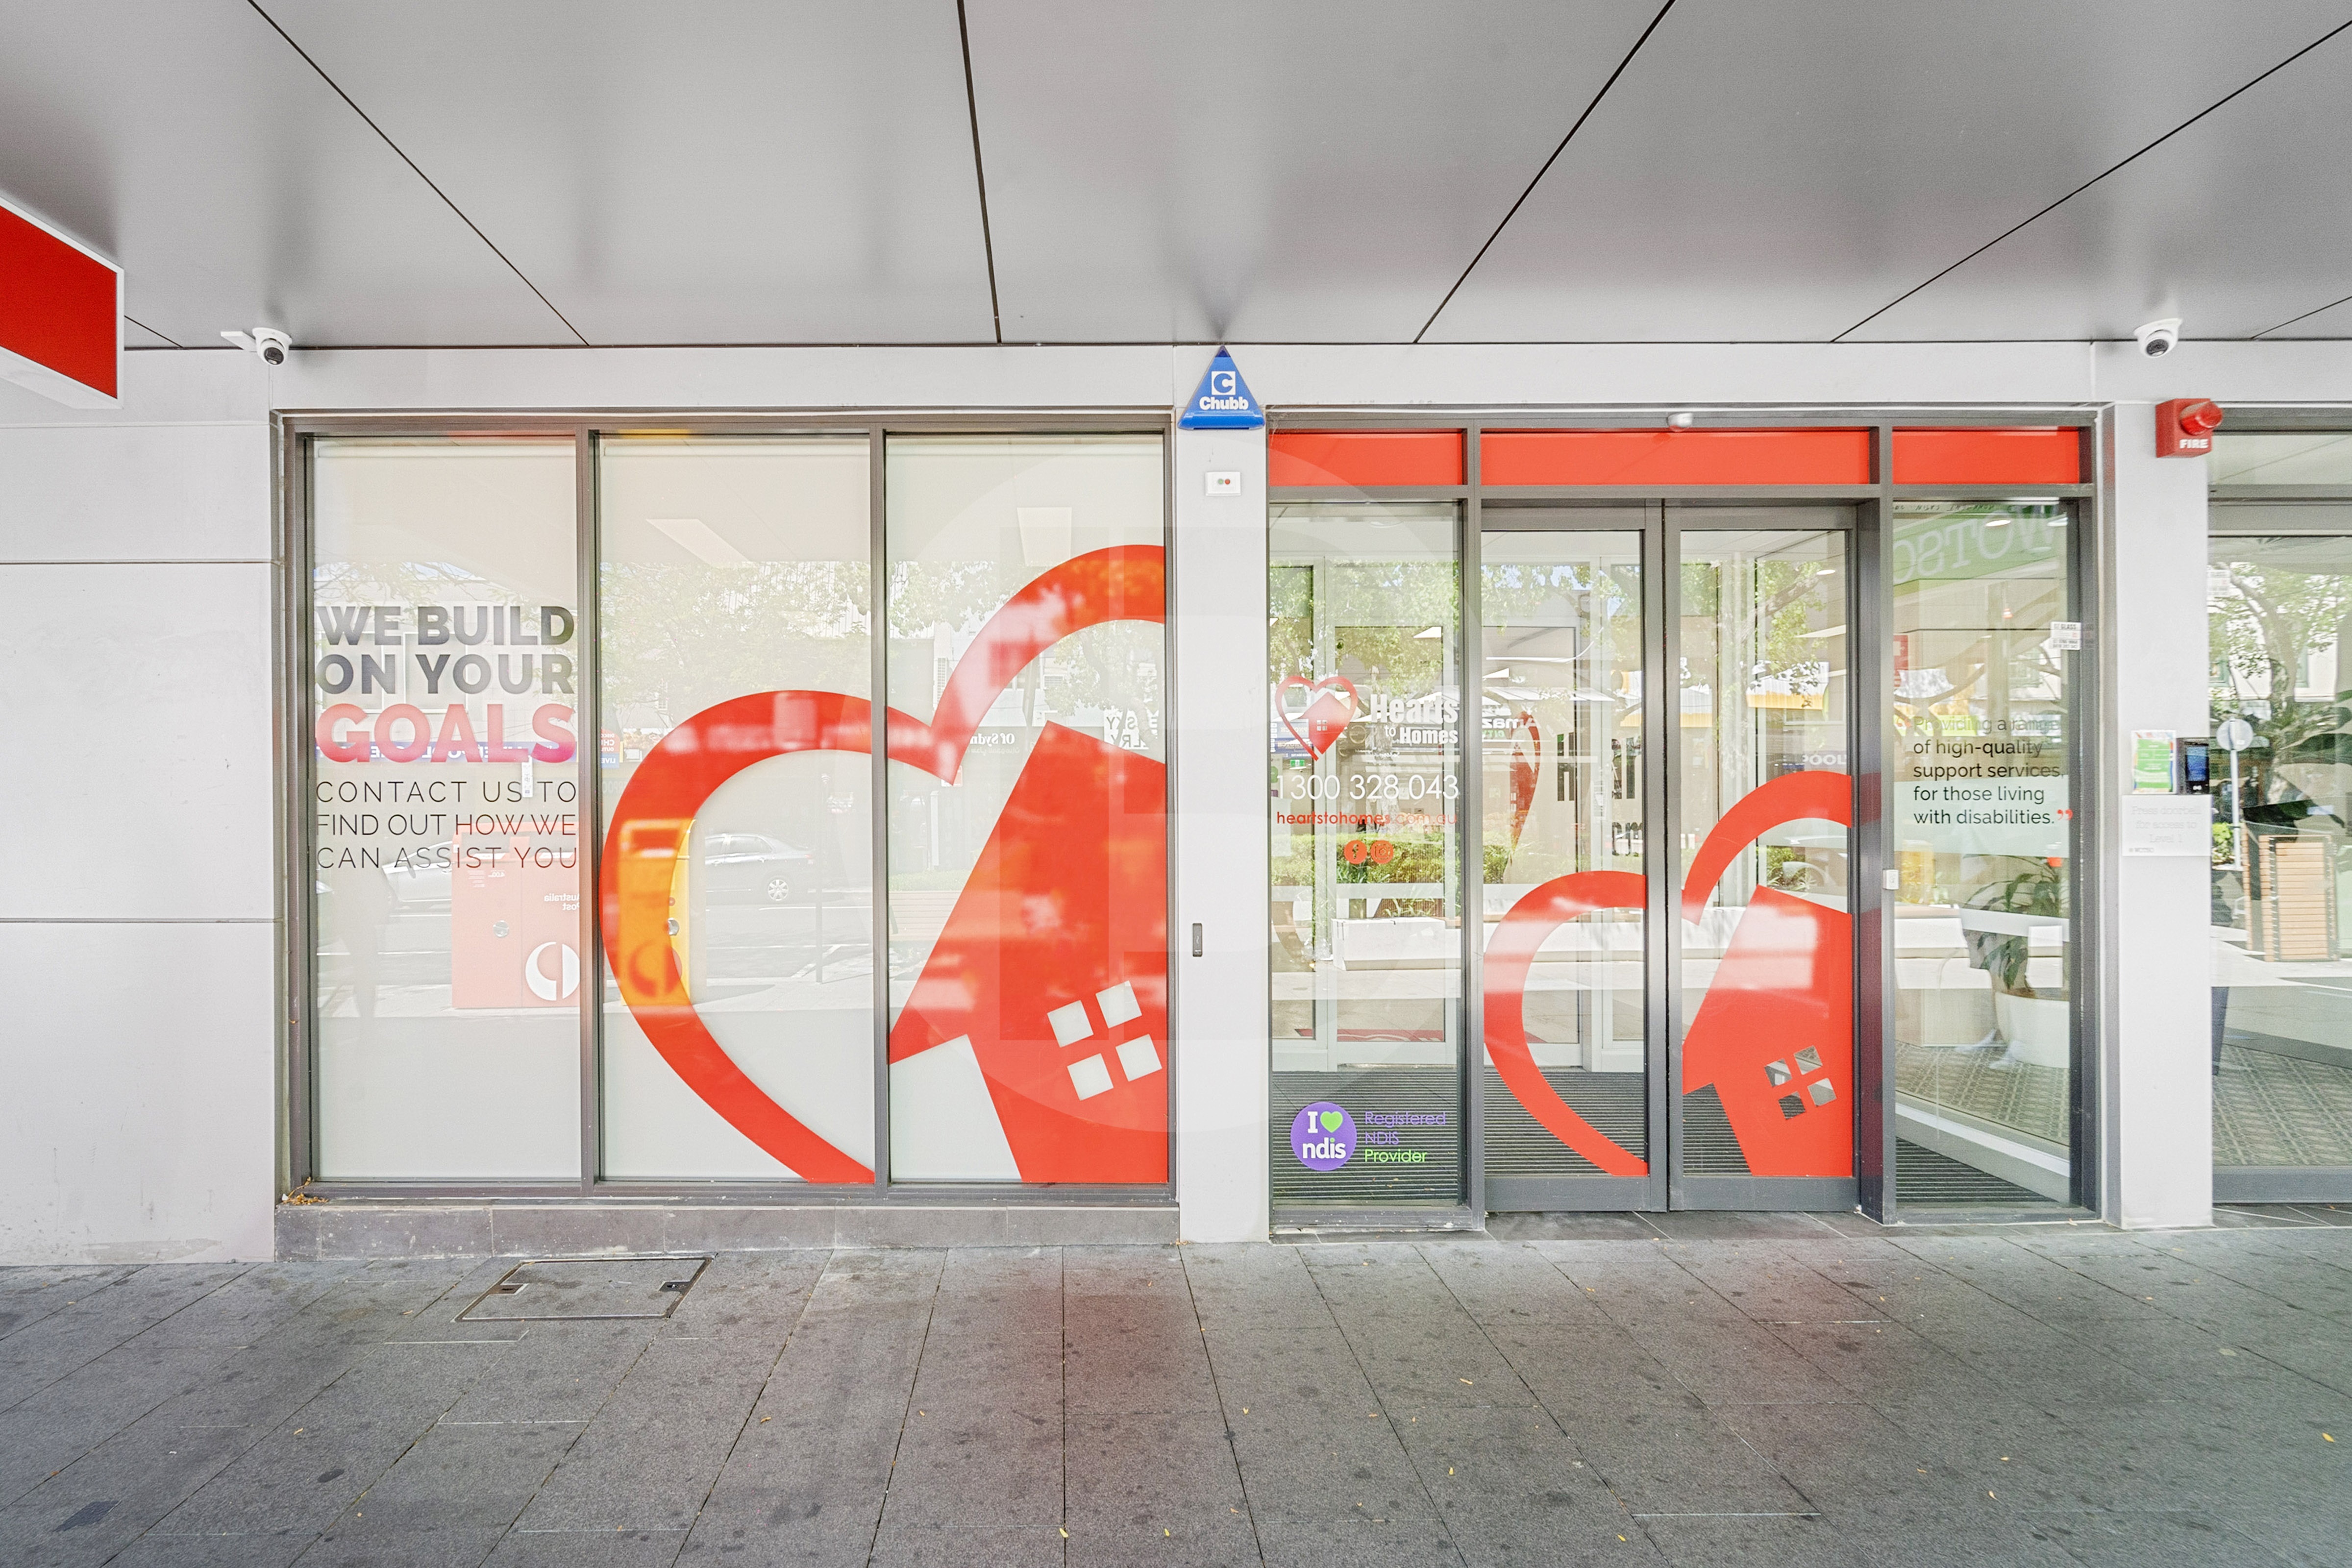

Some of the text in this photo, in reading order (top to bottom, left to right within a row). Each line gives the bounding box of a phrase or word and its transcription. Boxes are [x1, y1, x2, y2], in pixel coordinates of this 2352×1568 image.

[1199, 396, 1249, 410] Chubb
[2179, 439, 2209, 449] FIRE
[316, 606, 574, 646] WE BUILD
[316, 654, 575, 695] ON YOUR
[1370, 693, 1459, 725] Hearts
[315, 703, 576, 763] GOALS
[1385, 724, 1459, 745] to Homes
[1997, 720, 2006, 731] a
[1913, 739, 2042, 758] of high-quality
[1913, 763, 2064, 781] support services,
[316, 781, 576, 803] CONTACT US TO
[1276, 774, 1459, 800] 1300 328 043
[1913, 786, 2044, 804] for those living
[317, 814, 576, 835] FIND OUT HOW WE
[1277, 810, 1458, 826] heartstohomes.com.au
[1913, 809, 1951, 824] with
[317, 847, 577, 869] CAN ASSIST YOU
[1307, 1111, 1318, 1133] I
[1364, 1111, 1446, 1128] Registered
[1302, 1137, 1346, 1159] ndis
[1364, 1131, 1400, 1145] NDIS
[1364, 1149, 1428, 1163] Provider
